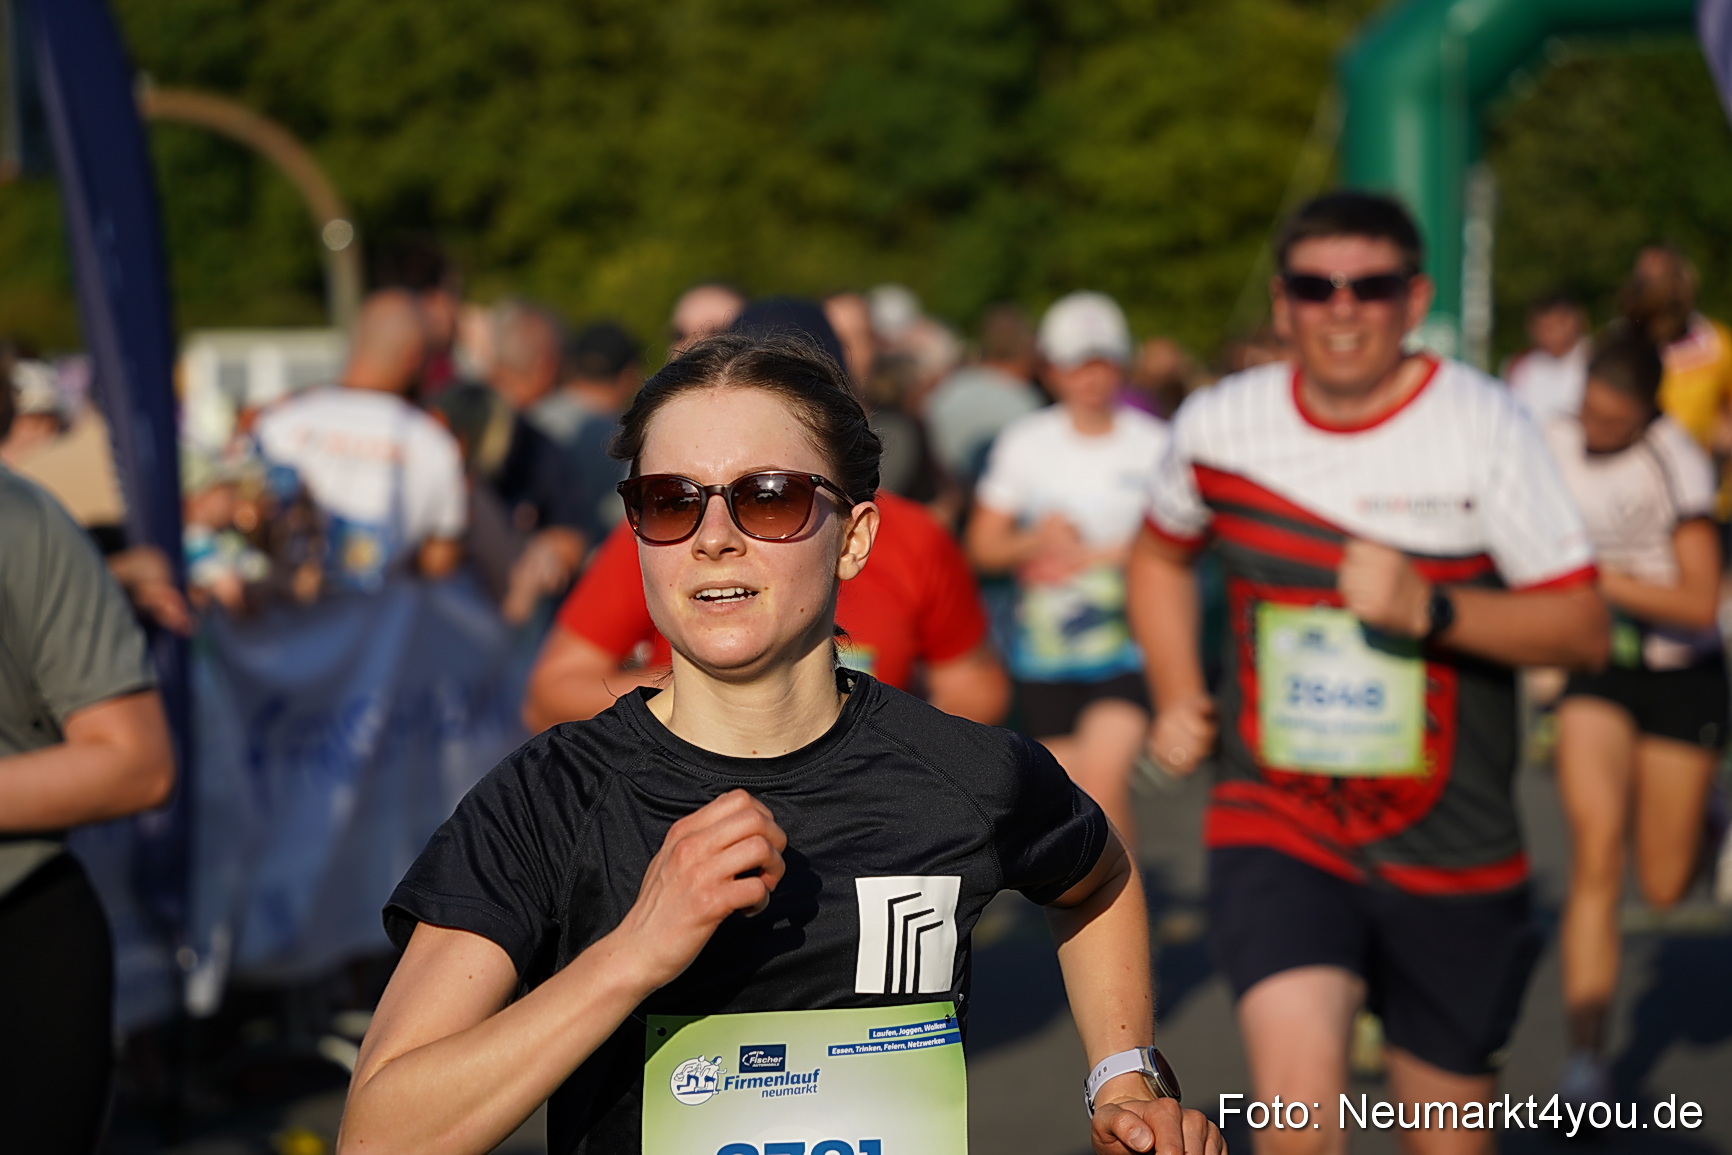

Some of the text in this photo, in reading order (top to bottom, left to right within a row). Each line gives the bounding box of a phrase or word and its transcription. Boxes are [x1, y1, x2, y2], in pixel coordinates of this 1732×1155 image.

[872, 1022, 947, 1037] Laufen, Joggen, Walken
[831, 1037, 946, 1055] Essen, Trinken, Feiern, Netzwerken
[749, 1055, 783, 1064] Fischer
[723, 1069, 820, 1091] Firmenlauf
[761, 1084, 818, 1099] neumarkt
